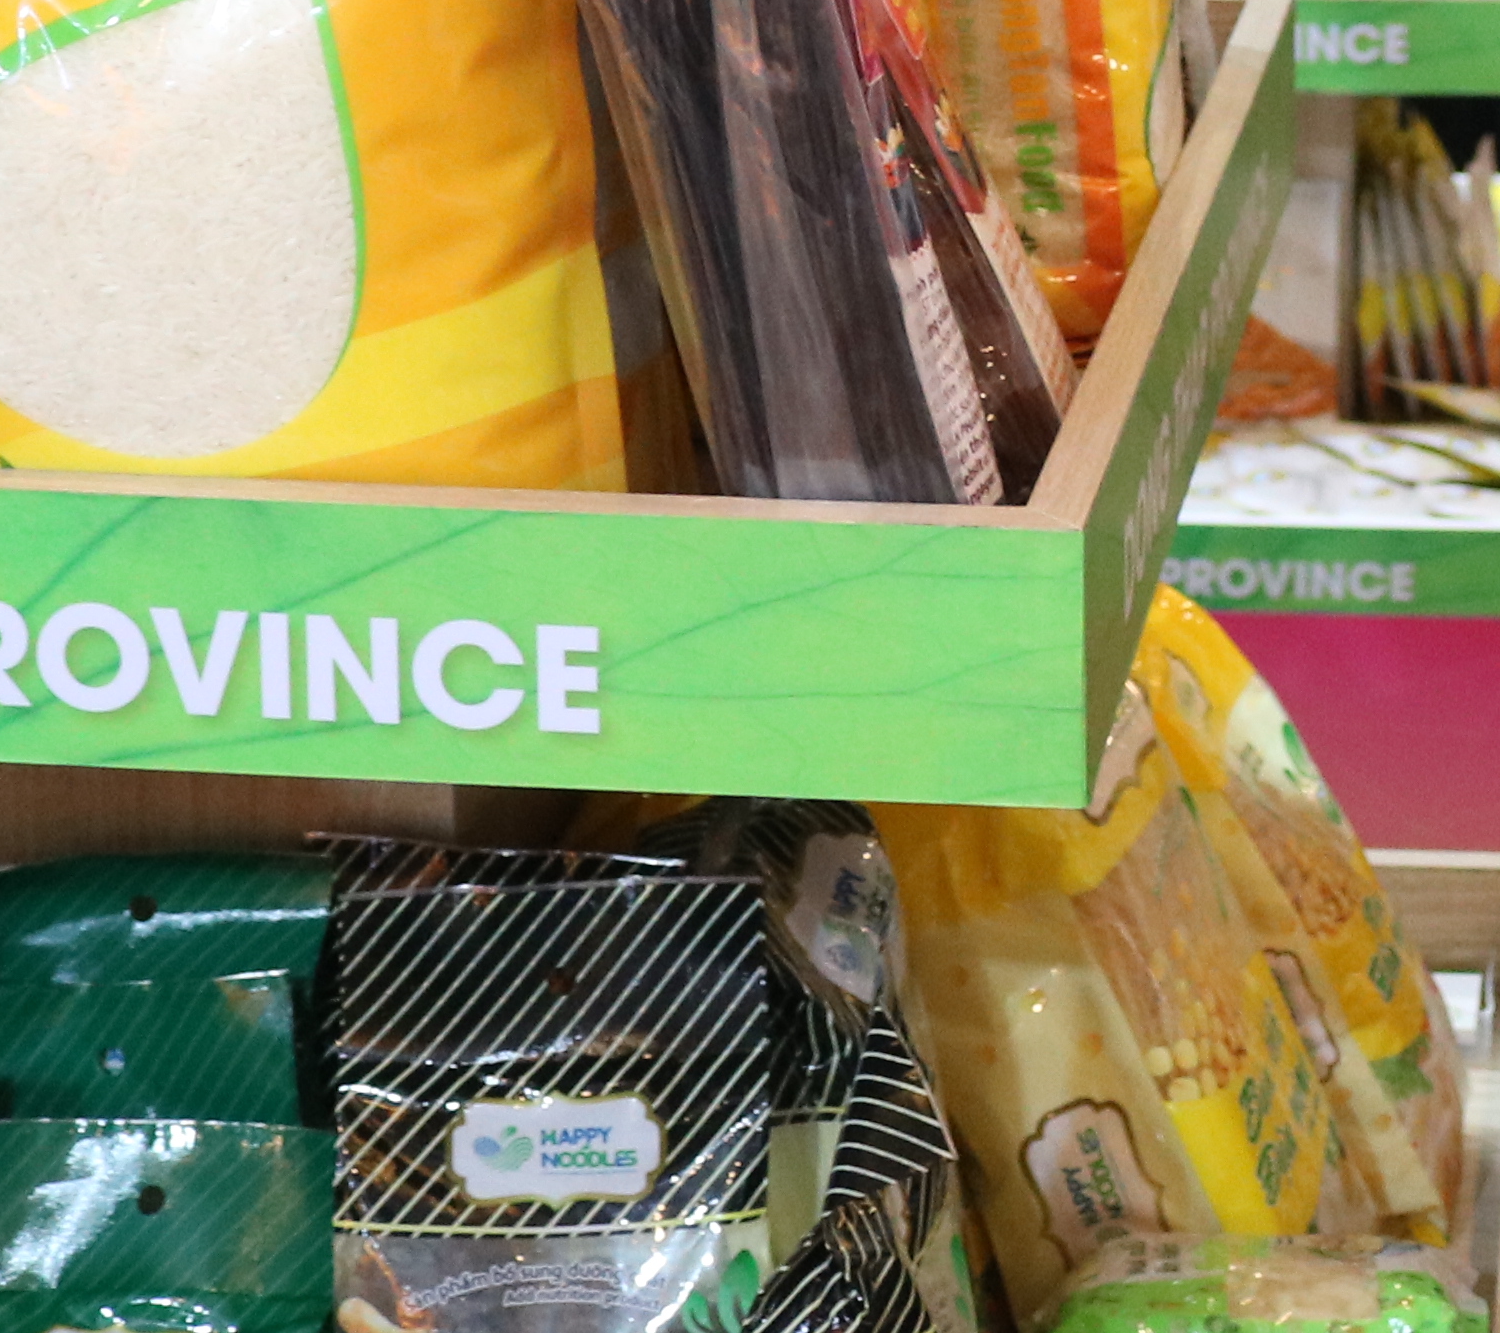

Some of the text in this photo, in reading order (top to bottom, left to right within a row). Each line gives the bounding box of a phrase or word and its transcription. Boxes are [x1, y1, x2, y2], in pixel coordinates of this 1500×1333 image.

[1158, 556, 1416, 604] PROVINCE
[540, 1125, 613, 1146] HAPPY
[519, 1265, 565, 1285] sung
